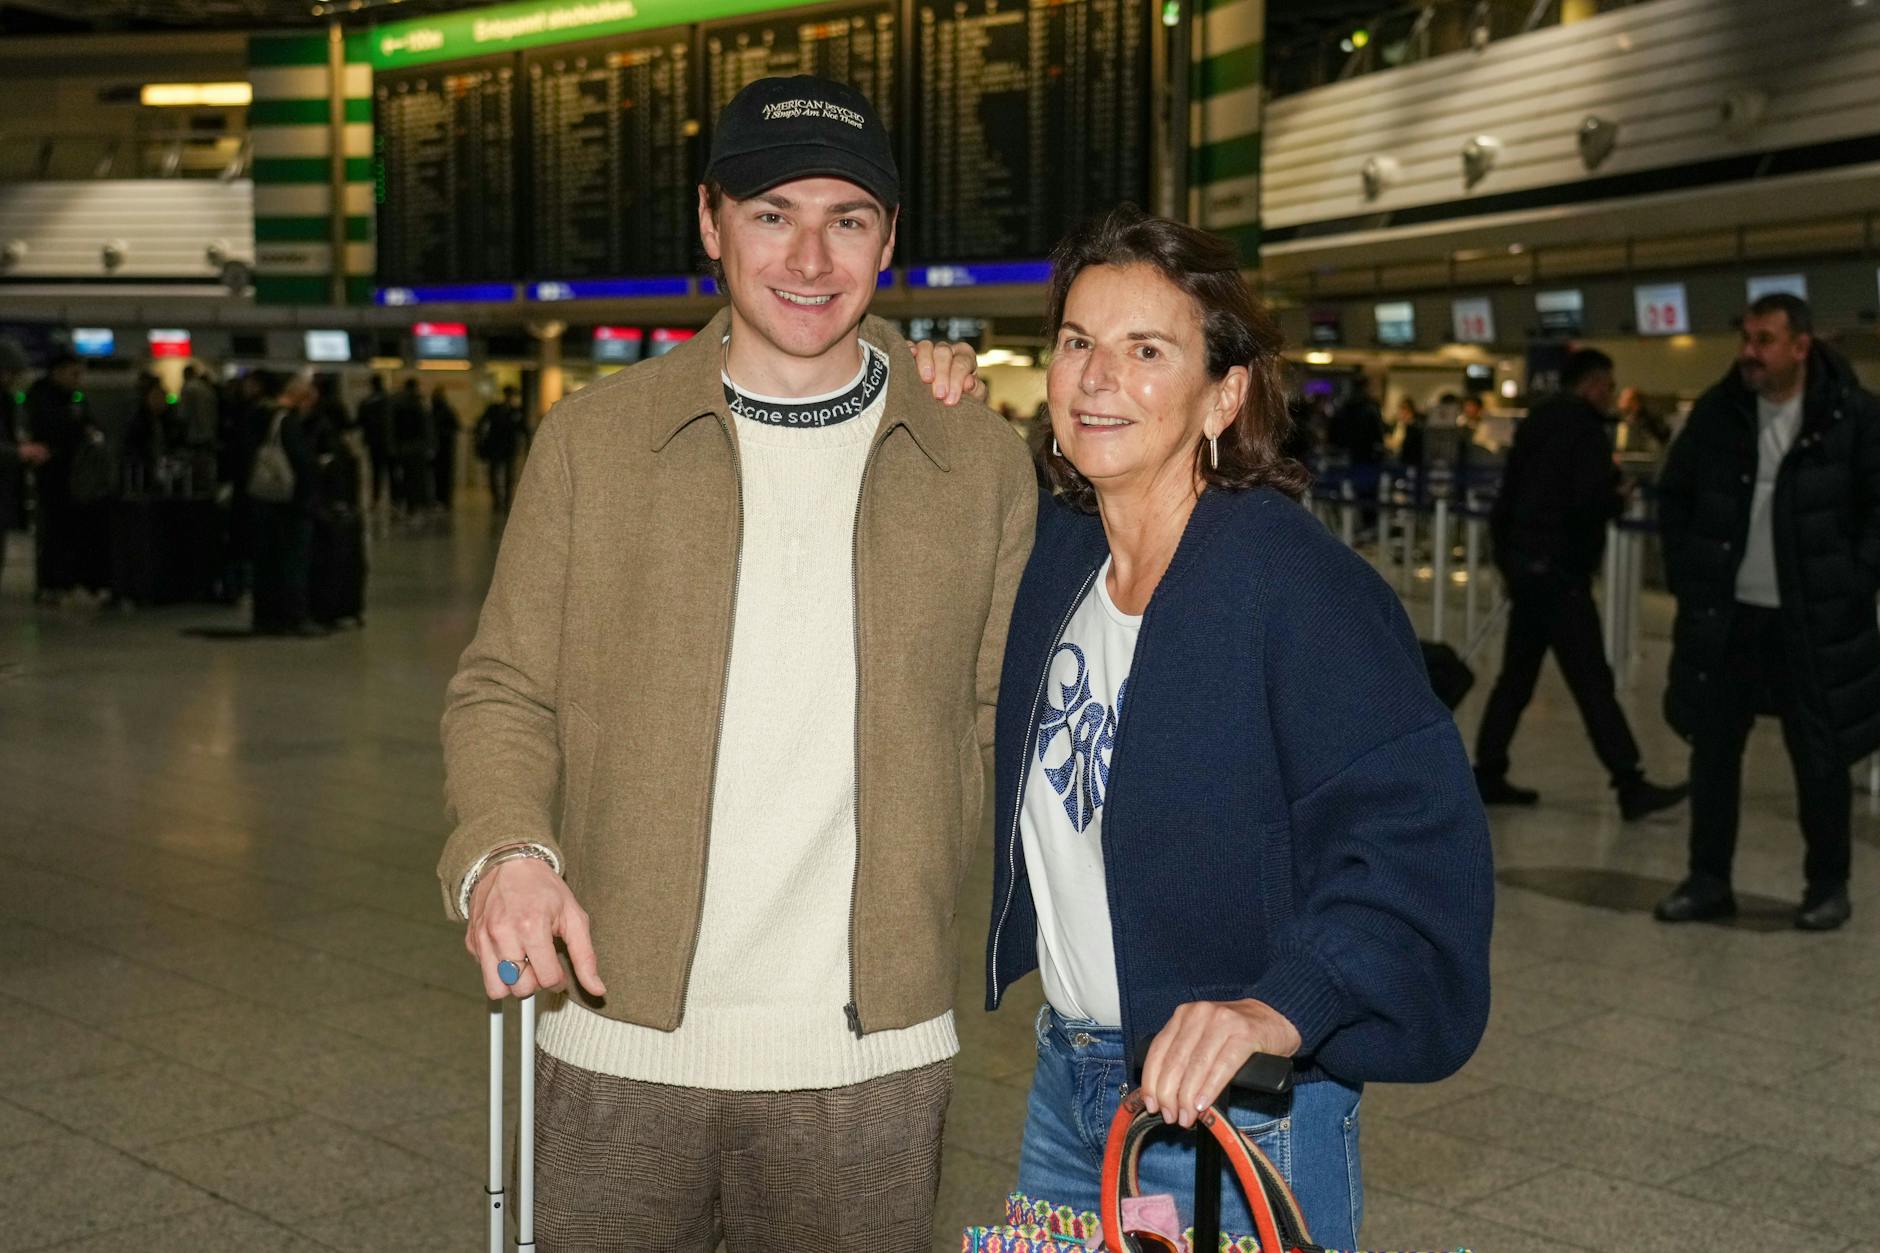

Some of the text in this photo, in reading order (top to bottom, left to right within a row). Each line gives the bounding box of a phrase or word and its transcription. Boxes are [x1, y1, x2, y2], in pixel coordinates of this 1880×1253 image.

[762, 99, 865, 124] AMERICAN PSYCHO
[764, 108, 863, 129] I Simply Am Not There
[862, 360, 884, 399] Acne
[728, 397, 783, 423] Acne
